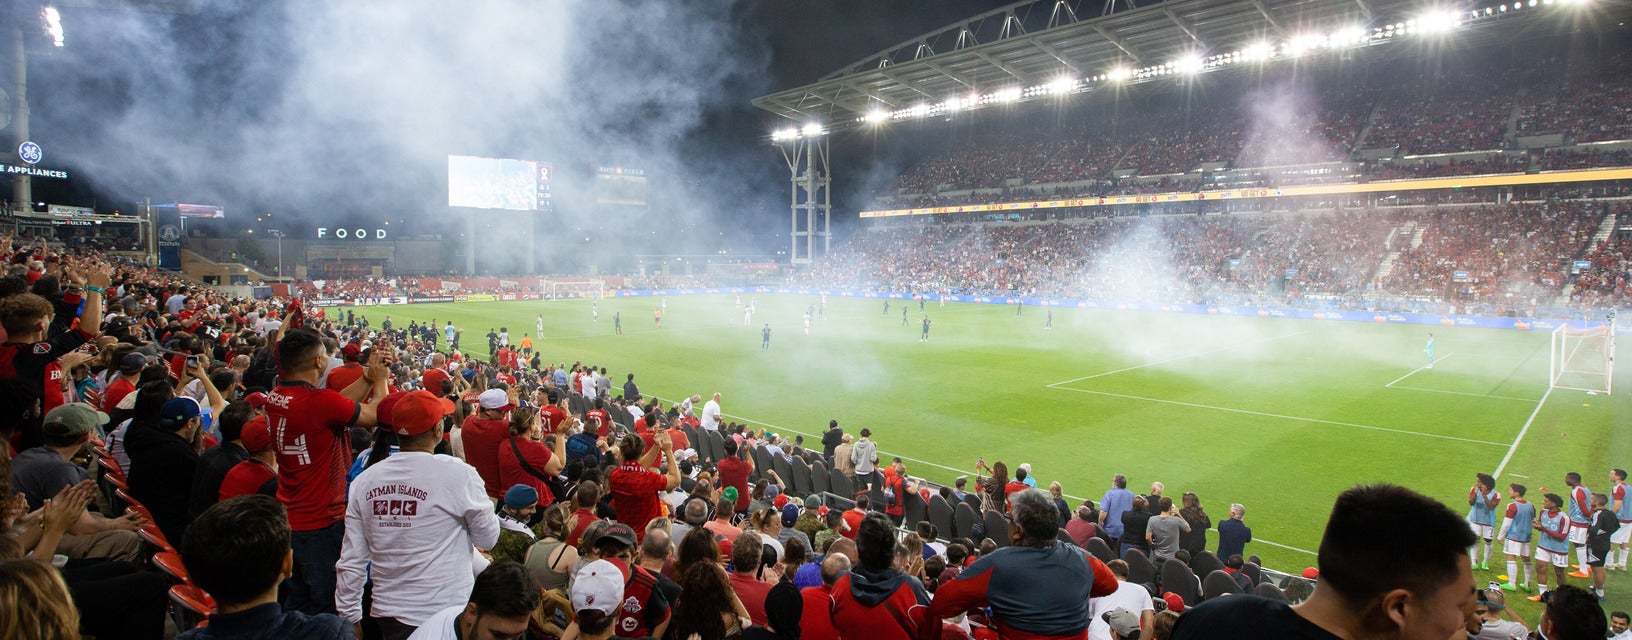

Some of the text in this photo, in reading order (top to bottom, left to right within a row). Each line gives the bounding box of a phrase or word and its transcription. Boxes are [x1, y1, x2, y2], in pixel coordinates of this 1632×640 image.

[7, 165, 68, 179] APPLIANCES
[317, 227, 387, 239] FOOD
[366, 485, 428, 501] CAYMAN ISLANDS
